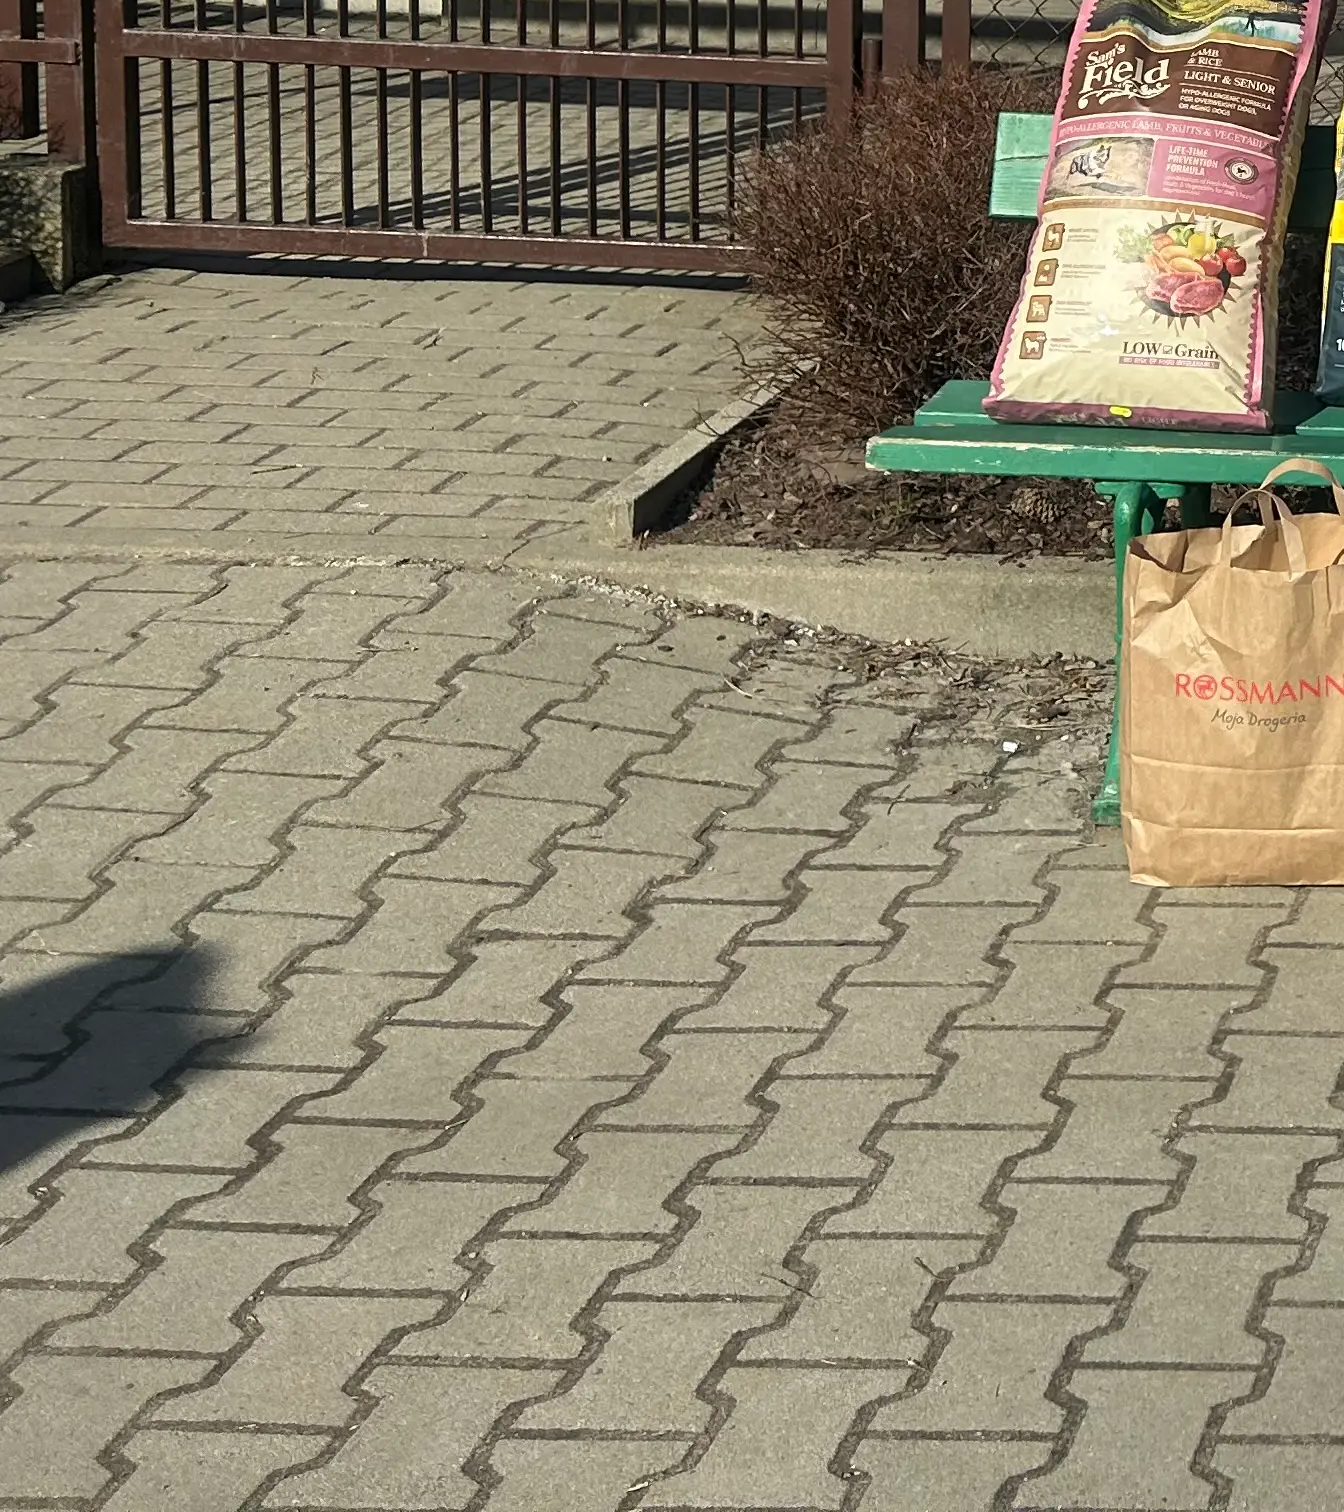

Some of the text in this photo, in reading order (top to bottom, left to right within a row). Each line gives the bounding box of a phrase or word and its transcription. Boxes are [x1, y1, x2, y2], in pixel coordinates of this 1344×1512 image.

[1086, 43, 1126, 66] Sam's
[1198, 57, 1223, 66] RICE
[1079, 56, 1170, 94] Field
[1184, 71, 1276, 95] LIGHT & SENIOR
[1166, 123, 1201, 135] FRUITS
[1169, 145, 1208, 157] LIFE-TIME
[1168, 155, 1218, 168] PREVENTION
[1166, 164, 1205, 176] FORMULA
[1122, 341, 1219, 359] LOW Grain
[1211, 708, 1307, 733] Moja Drogeria
